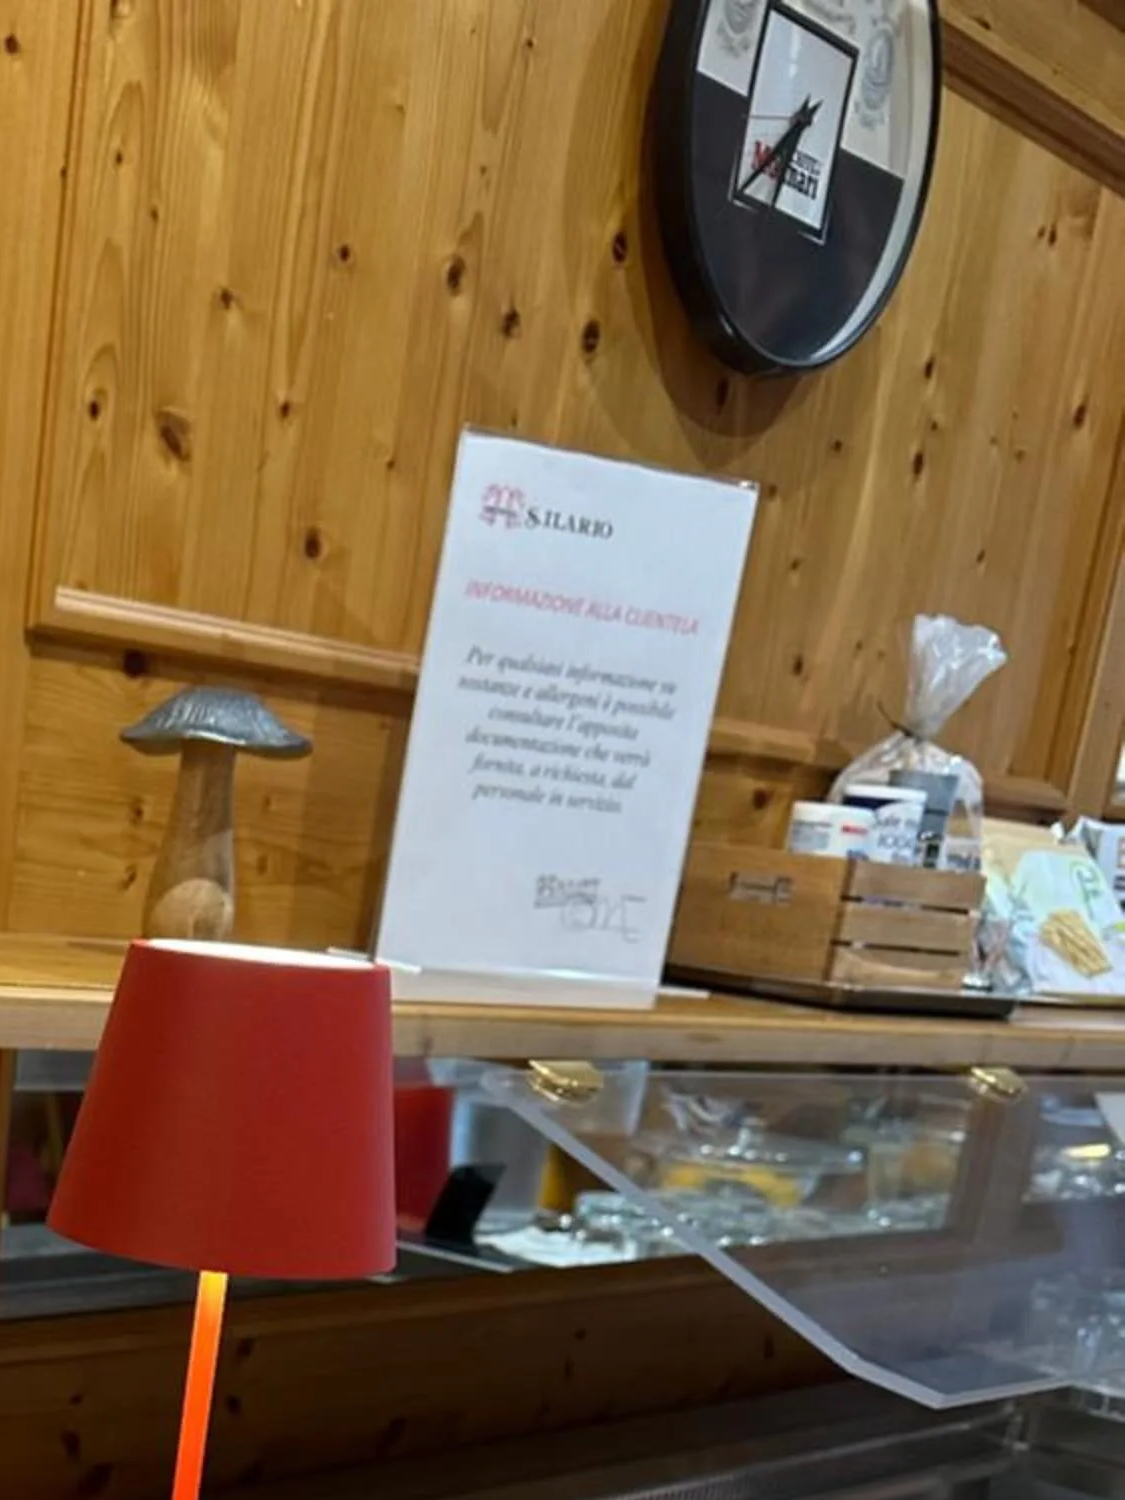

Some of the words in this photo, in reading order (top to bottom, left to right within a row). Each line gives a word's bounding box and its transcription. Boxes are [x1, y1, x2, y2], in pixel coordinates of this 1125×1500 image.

[465, 579, 585, 616] INFORMAZIONE
[585, 600, 622, 621] ALLA
[625, 606, 699, 634] CLIENTELA
[467, 645, 494, 666] Per
[565, 662, 658, 692] informazione
[488, 706, 566, 730] consultare
[611, 697, 676, 720] possibile
[465, 725, 583, 757] documentazione
[583, 743, 610, 762] che
[471, 783, 546, 804] personale
